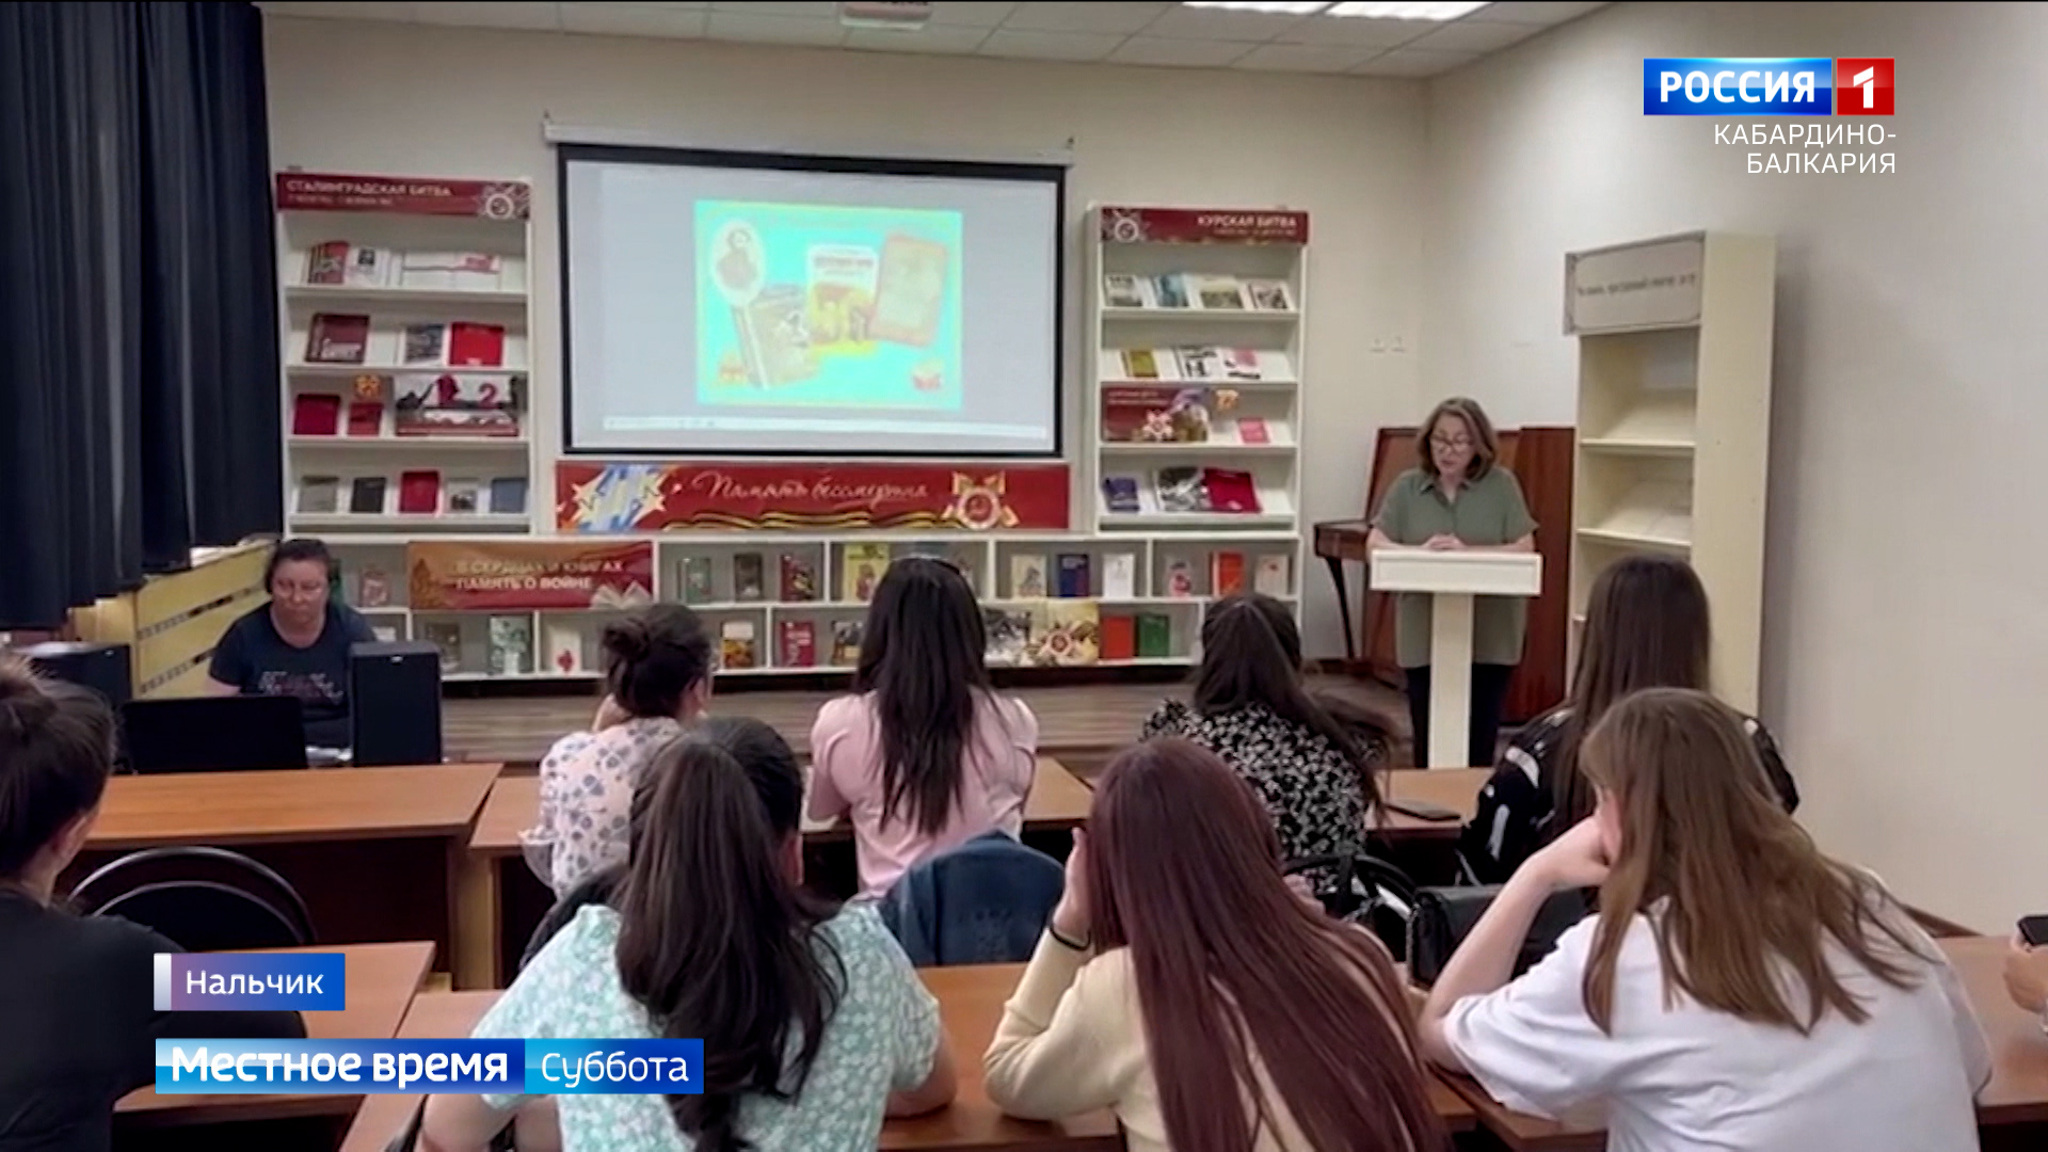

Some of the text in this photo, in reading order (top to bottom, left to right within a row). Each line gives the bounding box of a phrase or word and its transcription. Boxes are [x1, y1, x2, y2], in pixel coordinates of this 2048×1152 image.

[286, 180, 452, 197] СТАЛИНГРАДСКАЯ БИТВА
[1198, 214, 1297, 227] КУРСКАЯ БИТВА
[692, 470, 808, 499] Память
[456, 575, 592, 590] ПАМЯТЬ О ВОЙНЕ
